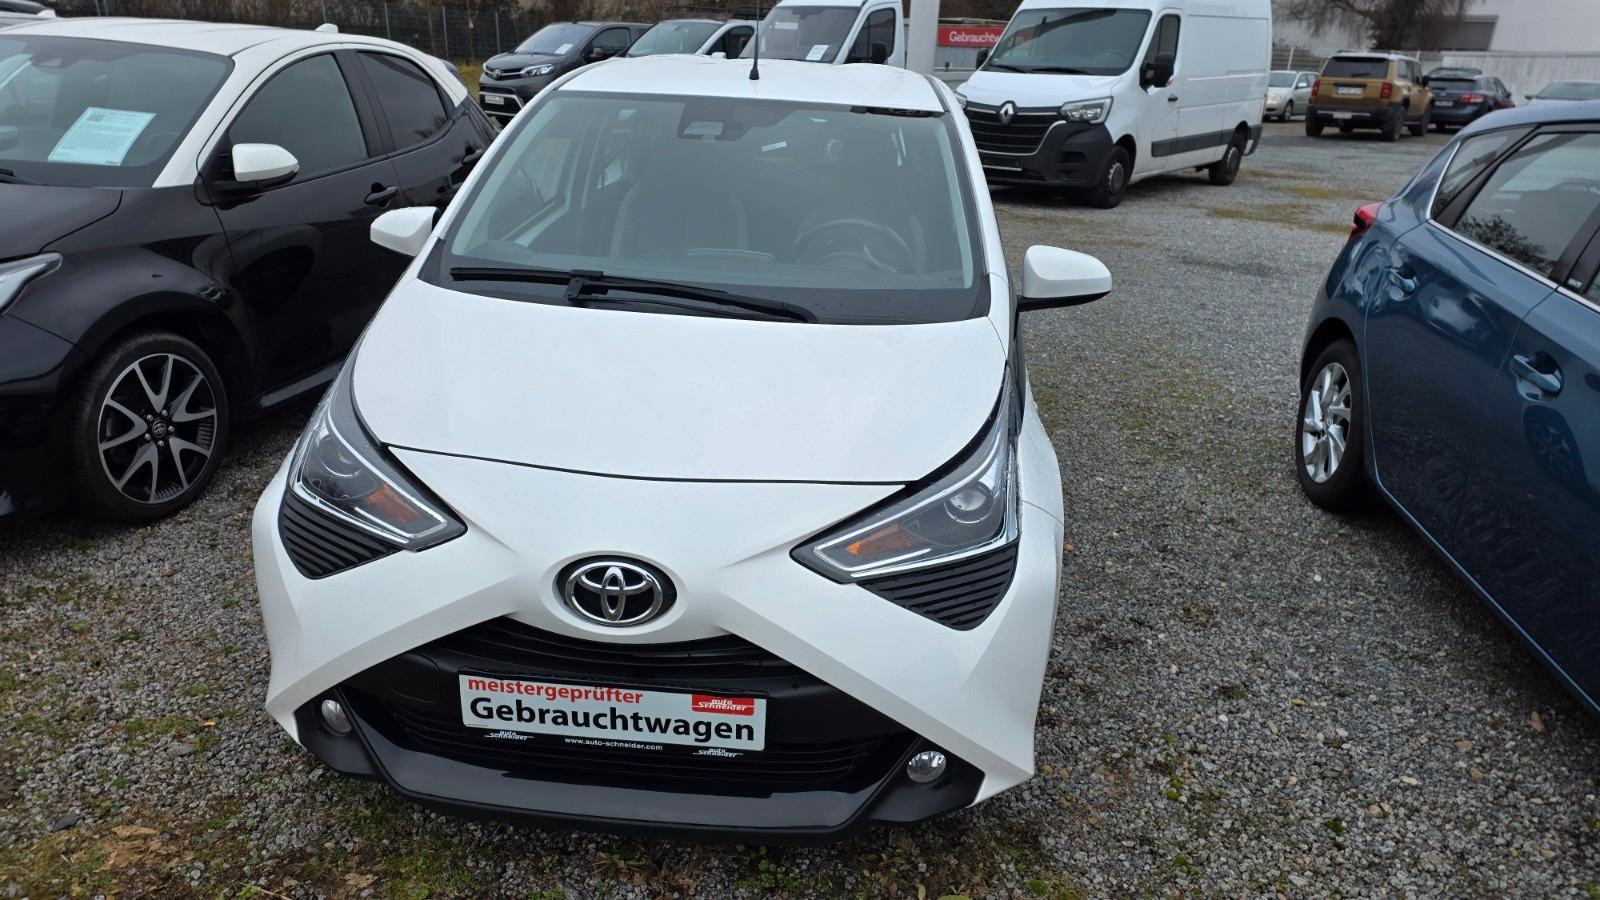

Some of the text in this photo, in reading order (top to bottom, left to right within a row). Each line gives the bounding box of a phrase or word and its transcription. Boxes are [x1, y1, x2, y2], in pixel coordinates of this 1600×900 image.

[468, 677, 643, 704] meistergeprüfter
[711, 698, 733, 706] auto
[470, 696, 755, 743] Gebrauchtwagen
[565, 737, 663, 751] www.auto-schneider.com
